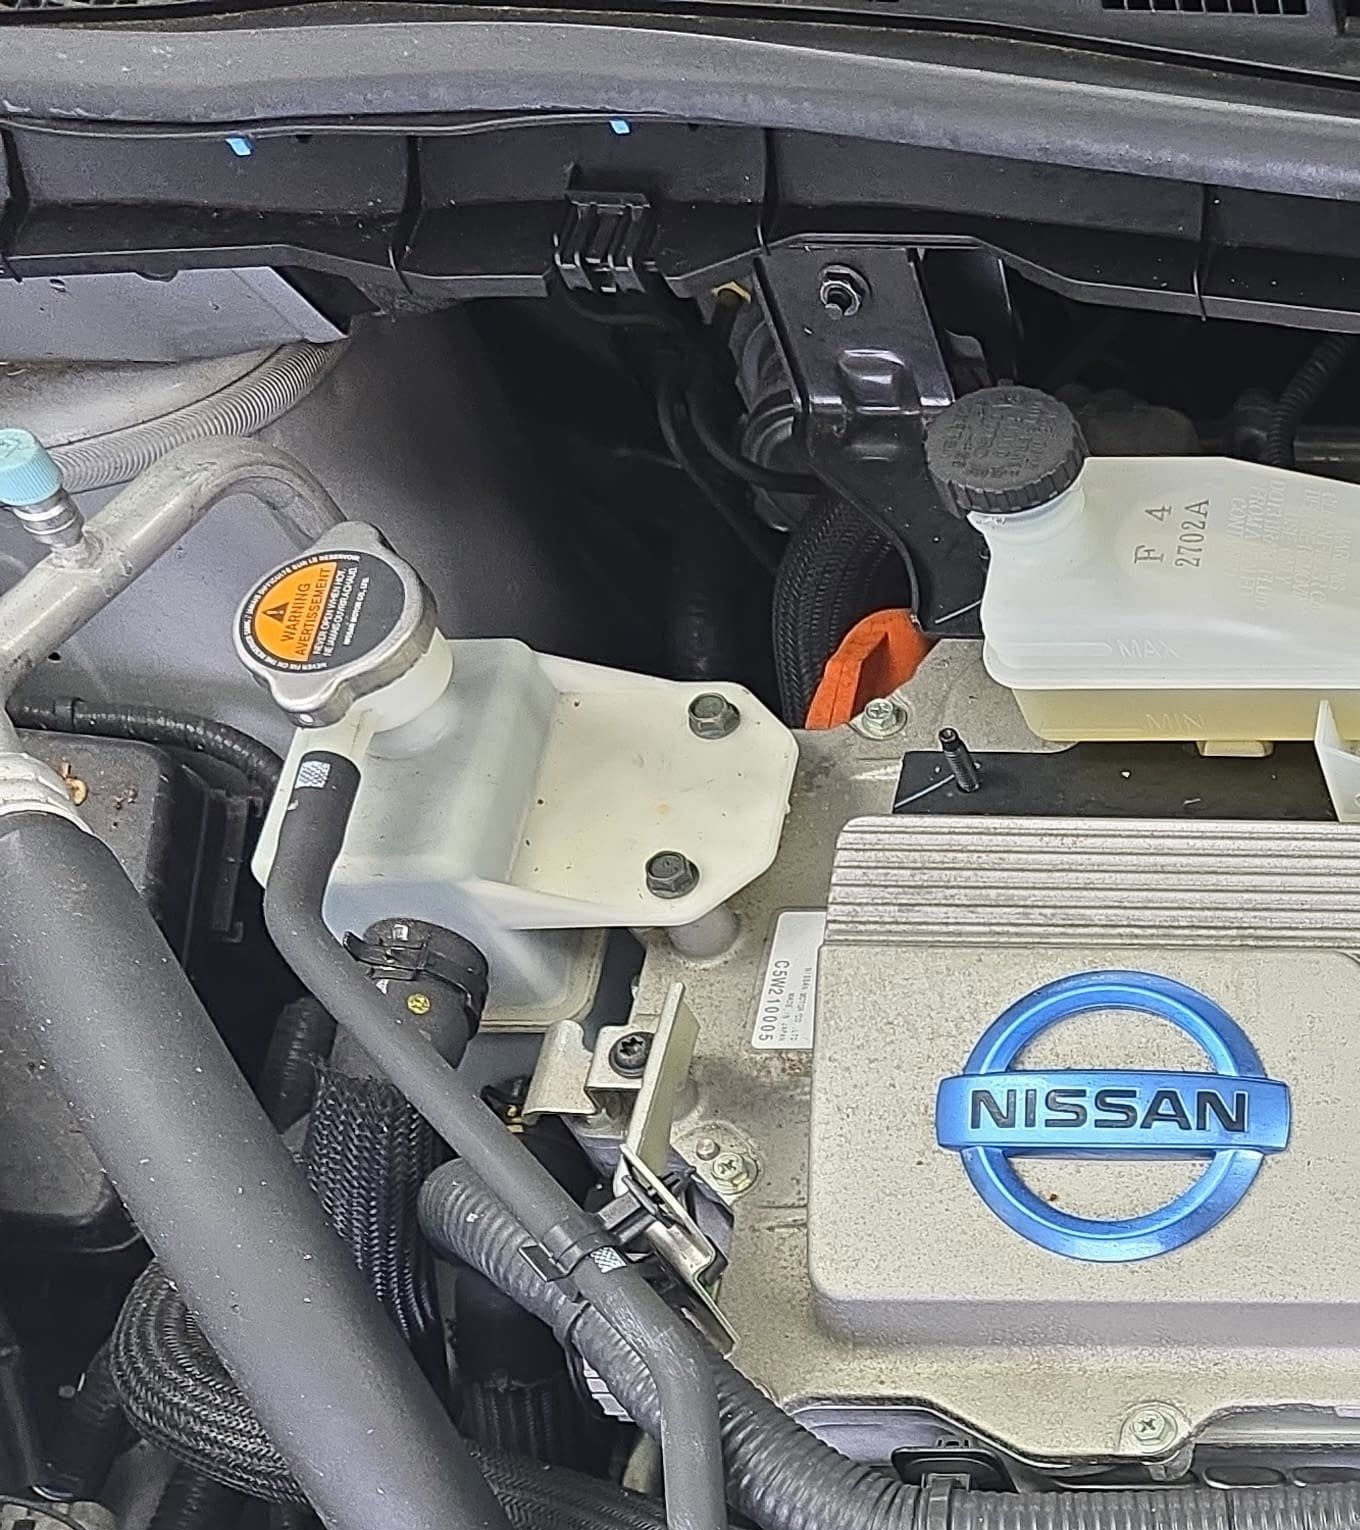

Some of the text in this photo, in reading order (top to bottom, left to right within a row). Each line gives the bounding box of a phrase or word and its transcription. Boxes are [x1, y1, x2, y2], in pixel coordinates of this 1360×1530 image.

[1134, 505, 1172, 564] F 4
[1174, 499, 1209, 567] 2702A
[280, 582, 311, 642] WARNING
[295, 567, 332, 656] AVERTISSEMENT
[758, 960, 790, 1041] C5W210005
[970, 1089, 1248, 1133] NISSAN
